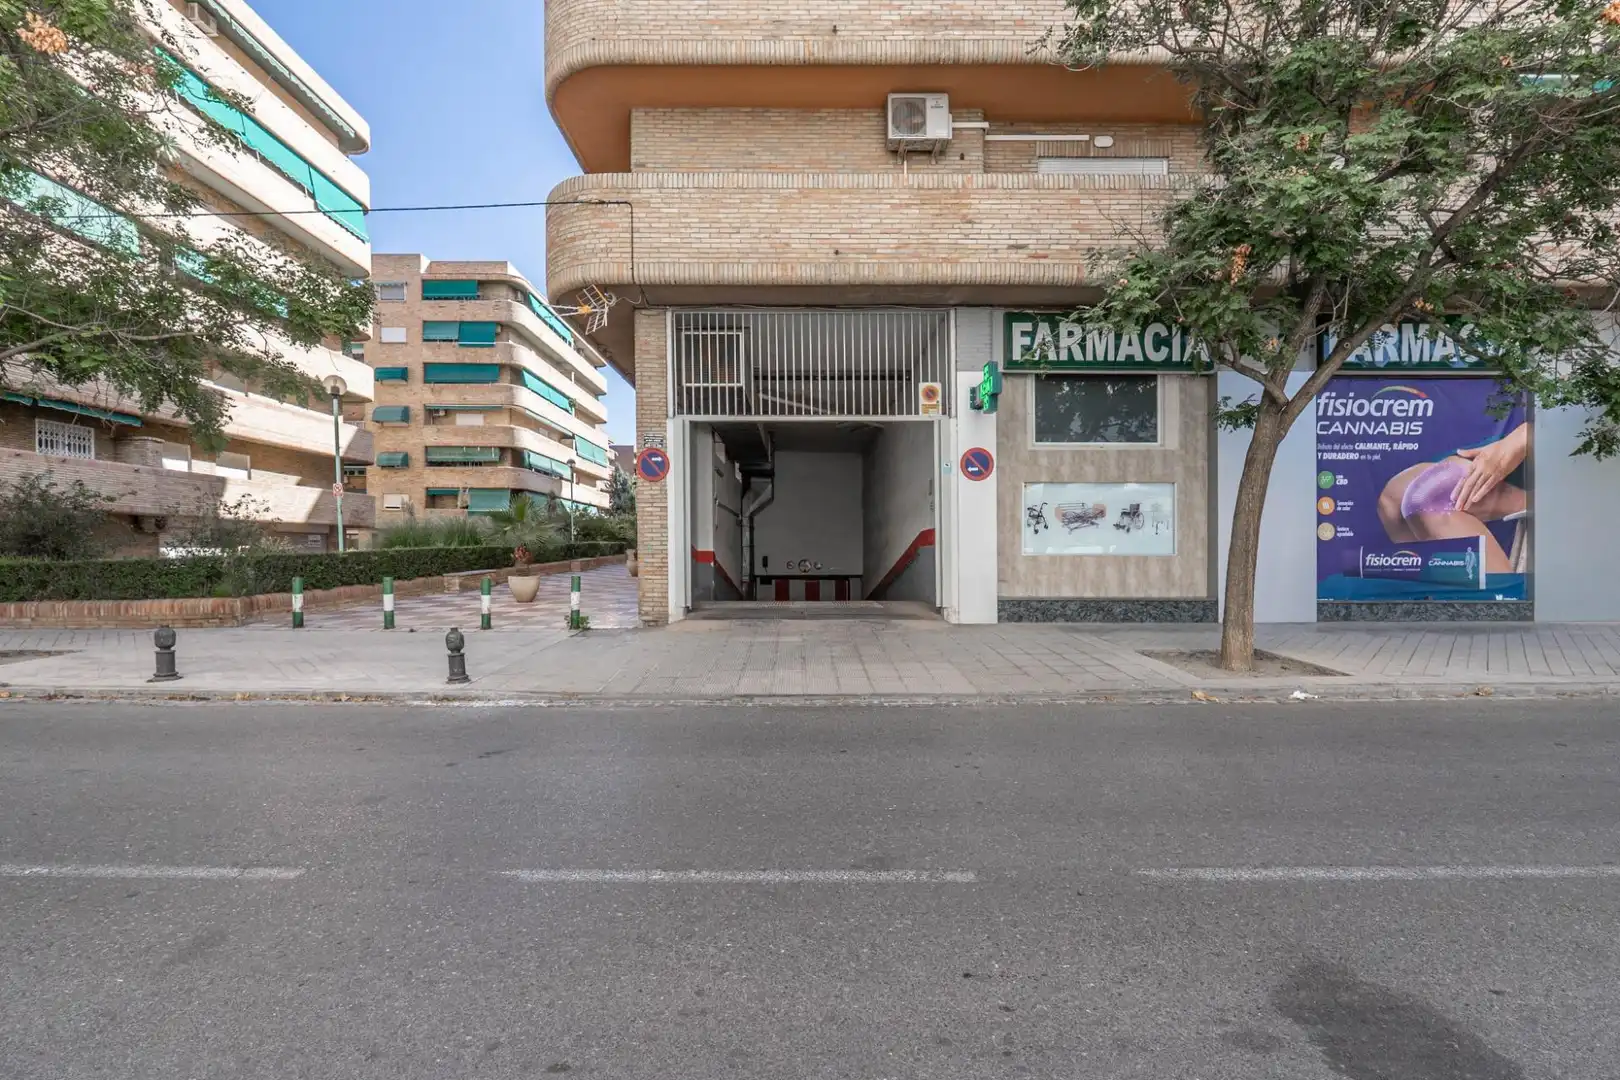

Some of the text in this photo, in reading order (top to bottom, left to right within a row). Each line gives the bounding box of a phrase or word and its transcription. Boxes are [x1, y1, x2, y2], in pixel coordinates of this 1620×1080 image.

[1012, 322, 1210, 362] FARMACIA
[1317, 392, 1434, 417] fisiocrem
[1316, 421, 1423, 435] CANNABIS
[1392, 441, 1419, 450] RÁPIDO
[1323, 452, 1360, 460] DURADERO
[1365, 553, 1422, 566] fisiocrem
